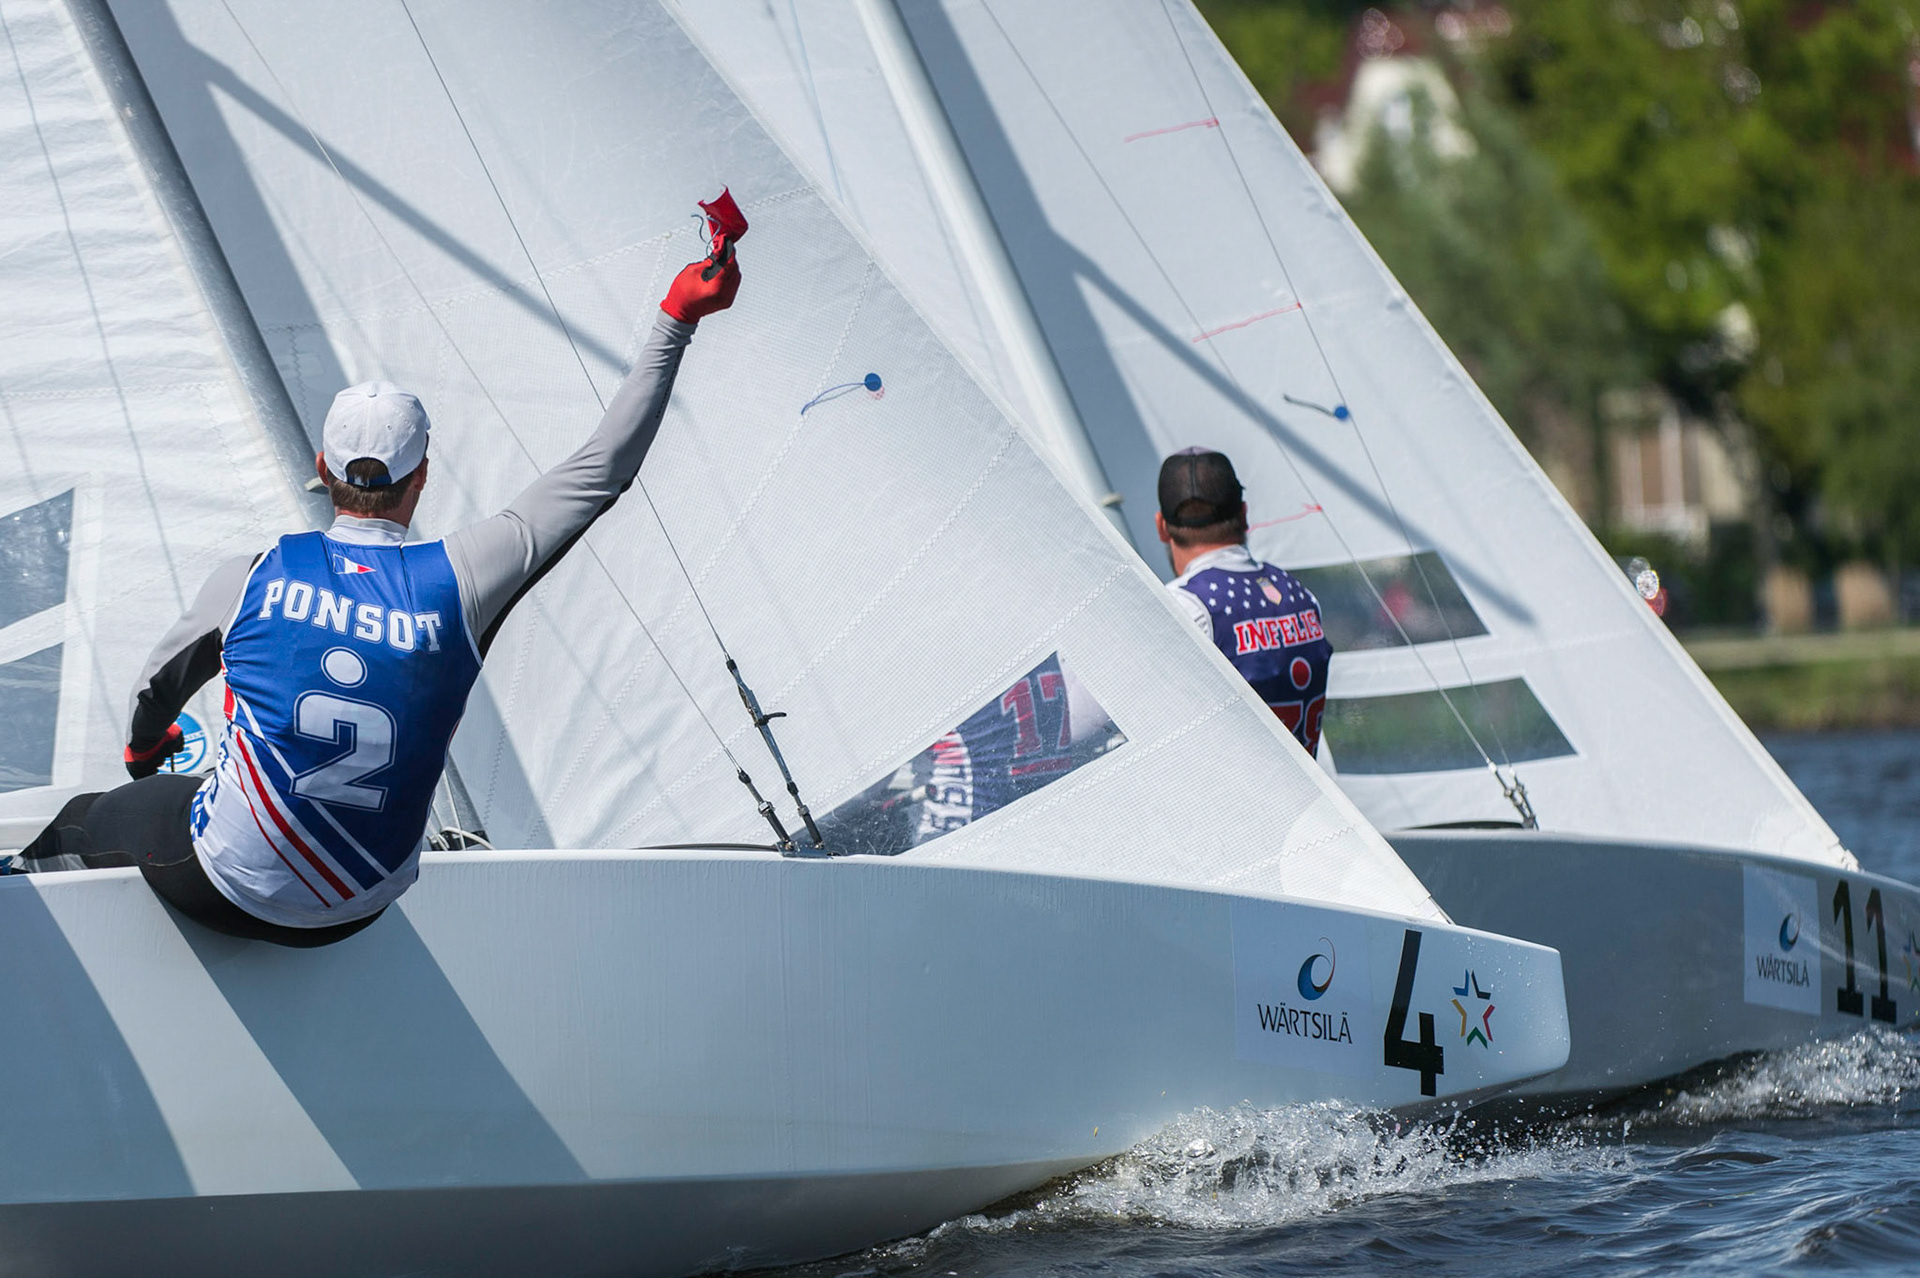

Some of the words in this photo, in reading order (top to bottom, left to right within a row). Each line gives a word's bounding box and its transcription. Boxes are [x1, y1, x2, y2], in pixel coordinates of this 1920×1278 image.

[257, 577, 444, 654] PONSOT
[289, 689, 397, 812] 2
[1001, 671, 1072, 759] 17
[1756, 952, 1810, 988] WÄRTSILÄ
[1833, 879, 1897, 1024] 11
[1257, 1002, 1353, 1044] WÄRTSILÄ
[1384, 929, 1445, 1097] 4
